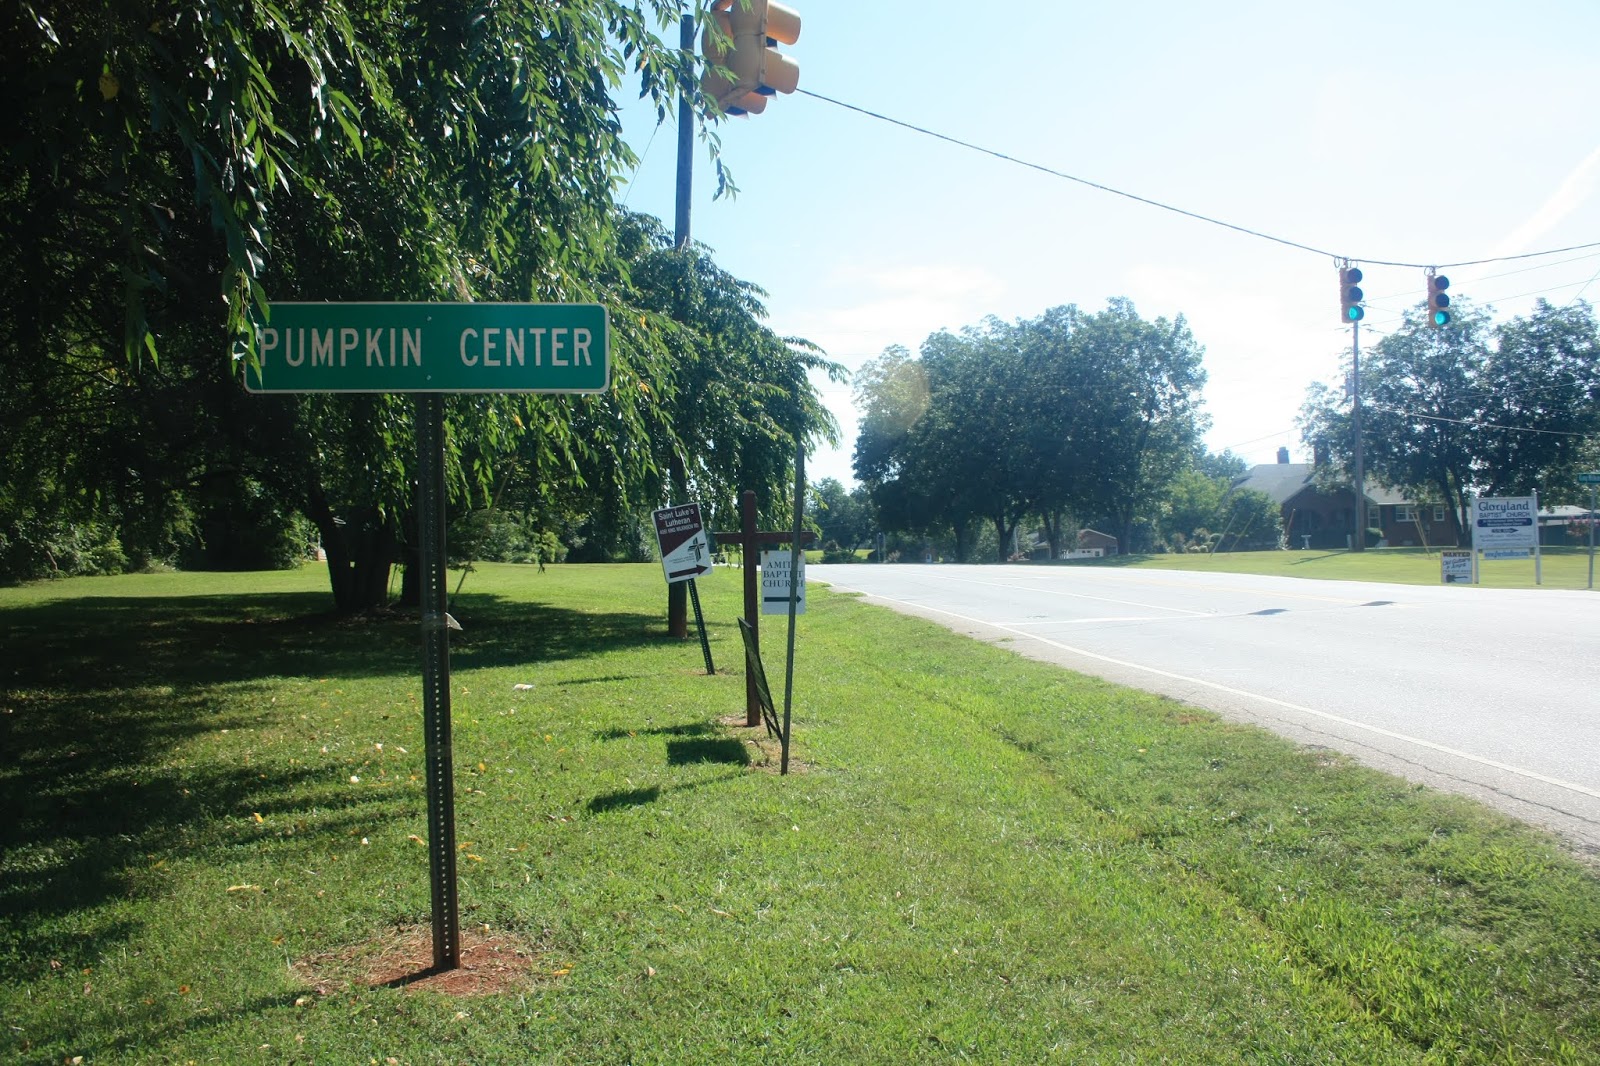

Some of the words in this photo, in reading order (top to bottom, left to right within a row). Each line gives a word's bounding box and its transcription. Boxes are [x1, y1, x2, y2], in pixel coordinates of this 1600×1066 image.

[260, 327, 422, 367] PUMPKIN
[459, 327, 592, 367] CENTER
[1478, 500, 1530, 514] Gloryland
[658, 511, 674, 521] Saint
[674, 507, 695, 518] Luke's
[665, 517, 691, 528] Lutheran
[767, 561, 796, 569] AMIT
[762, 580, 804, 588] CHURH
